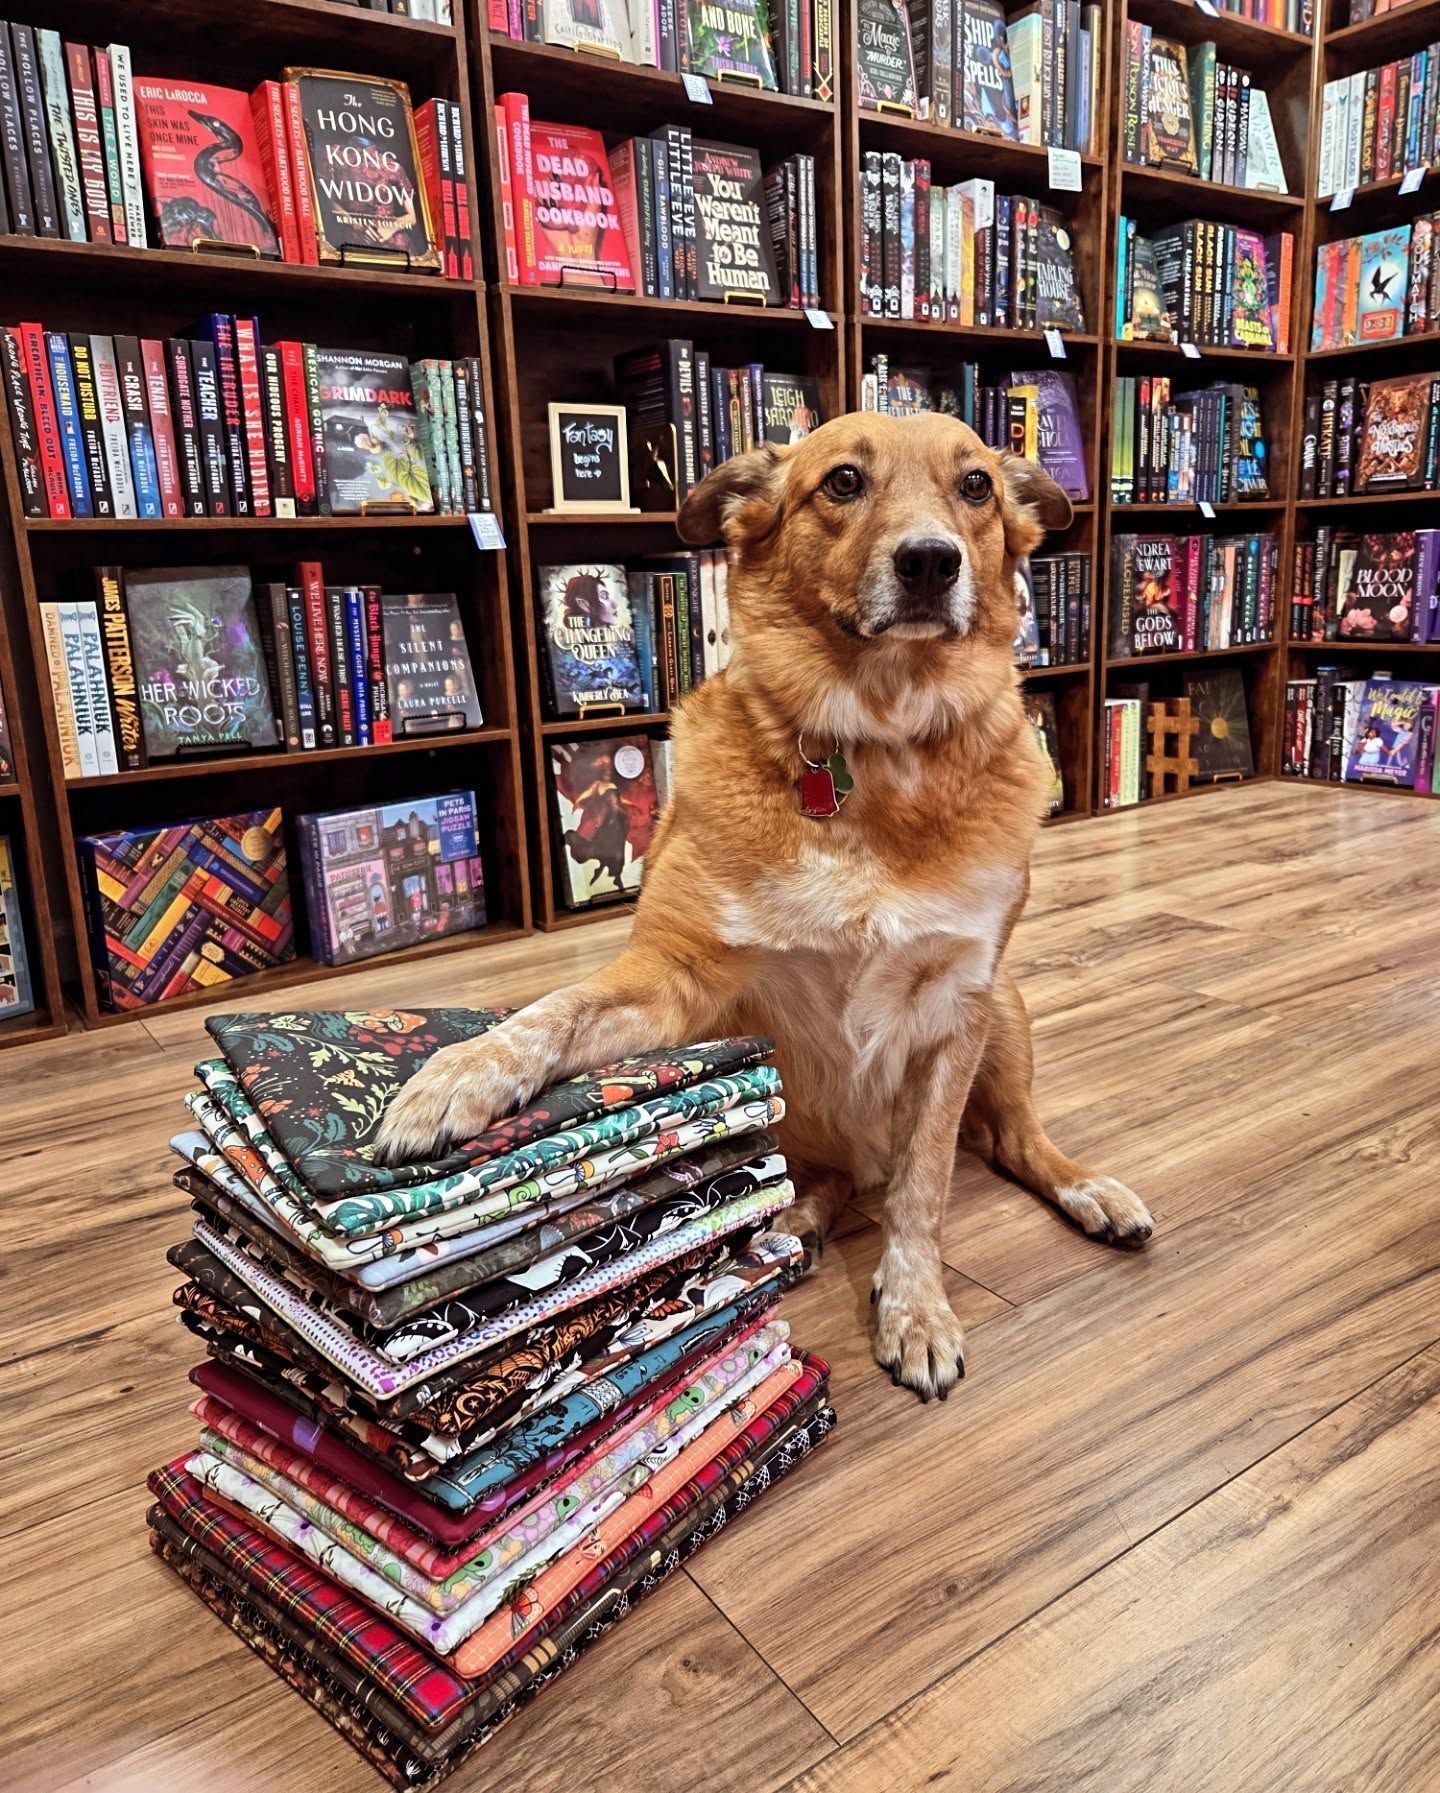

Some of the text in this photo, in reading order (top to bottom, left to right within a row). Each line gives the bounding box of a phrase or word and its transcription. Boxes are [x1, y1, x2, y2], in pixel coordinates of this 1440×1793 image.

[702, 5, 757, 39] AND BONE
[863, 20, 900, 51] Magic
[964, 12, 994, 47] SHIP
[865, 50, 905, 69] MURDER
[964, 58, 1004, 91] SPELLS
[1152, 54, 1180, 75] THIS
[18, 31, 42, 154] THE HOLLOW PLACES
[140, 86, 163, 99] ERIC
[344, 94, 362, 108] The
[1127, 25, 1140, 150] SON POISON ROSE
[116, 55, 135, 179] WE USED TO LIVE HERE
[144, 105, 165, 115] THIS
[1149, 96, 1190, 120] HUNGER
[1202, 75, 1214, 150] BEWITCHING
[4, 105, 17, 151] PLACES
[147, 118, 190, 131] SKIN WAS
[317, 109, 394, 138] HONG
[1215, 99, 1225, 151] GIDEON
[1227, 100, 1237, 152] GIDEON
[73, 87, 109, 220] THIS IS BODY
[150, 133, 199, 145] ONCE MINE
[512, 122, 525, 176] COOKBOOK
[548, 137, 569, 149] THE
[54, 130, 75, 183] TWISTED
[103, 115, 121, 198] THE WORD
[325, 145, 399, 172] KONG
[521, 124, 535, 195] DEAD HUSBAND
[536, 154, 590, 177] DEAD
[657, 159, 665, 181] GIRL
[295, 148, 308, 196] HARTWOOD
[668, 130, 684, 235] LITTLE EVE
[680, 133, 696, 238] LITTLE EVE
[707, 173, 743, 200] You
[725, 167, 753, 179] WHITE
[319, 178, 415, 206] WIDOW
[658, 195, 669, 249] RAWBLOOD
[694, 193, 761, 224] Weren't
[703, 216, 760, 245] Meant
[1196, 223, 1204, 263] BLACK
[713, 243, 759, 267] to Be
[1205, 225, 1214, 293] BLACK SUN
[706, 262, 770, 290] Human
[1409, 237, 1424, 323] SOULMATCH
[1235, 318, 1262, 329] BEASTS
[216, 323, 240, 427] THE INTRUDER
[317, 355, 402, 370] SHANNON MORGAN
[678, 360, 692, 394] DEVILS
[698, 361, 706, 378] THIS
[4, 334, 28, 430] WRONG PLACE WRONG
[55, 362, 73, 416] HOUSEMAID
[74, 345, 97, 421] DO NOT DISTURB
[98, 362, 120, 424] BOYFRIEND
[124, 374, 143, 411] CRASH
[150, 374, 167, 416] TENANT
[175, 355, 193, 428] SURROGATE MOTHER
[198, 370, 218, 421] TEACHER
[319, 385, 412, 405] GRIMDARK
[742, 377, 750, 406] LEGENDS
[771, 387, 804, 406] LEIGH
[897, 387, 913, 401] THE
[266, 353, 286, 464] OUR HIDEOUS PROGENY
[306, 348, 325, 454] MEXICAN GOTHIC
[699, 381, 708, 414] MONSTER
[236, 328, 270, 507] WHAT IS SHE HIDING
[702, 416, 708, 425] OF
[45, 437, 55, 459] OUT
[294, 418, 303, 448] ADRIAN
[563, 422, 613, 454] Fantasy
[573, 452, 600, 467] begins
[684, 421, 695, 483] JOE ABERCROMBIE
[575, 469, 593, 478] here
[1356, 568, 1413, 584] BLOOD
[1356, 583, 1405, 598] MOON
[1122, 552, 1131, 635] ALCHEMISED
[310, 582, 328, 683] WE LIVE HERE NOW
[568, 616, 585, 628] THE
[1136, 615, 1172, 632] GODS
[293, 606, 308, 697] LOUISE PENNY
[353, 619, 363, 678] MYSTERY GUEST
[400, 640, 443, 654] SILENT
[554, 626, 631, 650] CHANGELING
[1134, 631, 1176, 649] BELOW
[102, 578, 139, 753] JAMES PATTERSON Writer
[385, 659, 465, 676] COMPANIONS
[571, 644, 616, 664] QUEEN
[65, 633, 92, 736] PALAHNIUK
[83, 632, 110, 734] PALAHNIUK
[141, 678, 260, 703] HER WICKED
[572, 689, 607, 706] KIMBERLY
[165, 704, 246, 726] ROOTS
[398, 695, 467, 709] LAURA PURCELL
[1371, 702, 1419, 721] Magic
[1354, 765, 1383, 773] MARISSA
[441, 815, 470, 824] JIGSAW
[441, 823, 472, 832] PUZZLE
